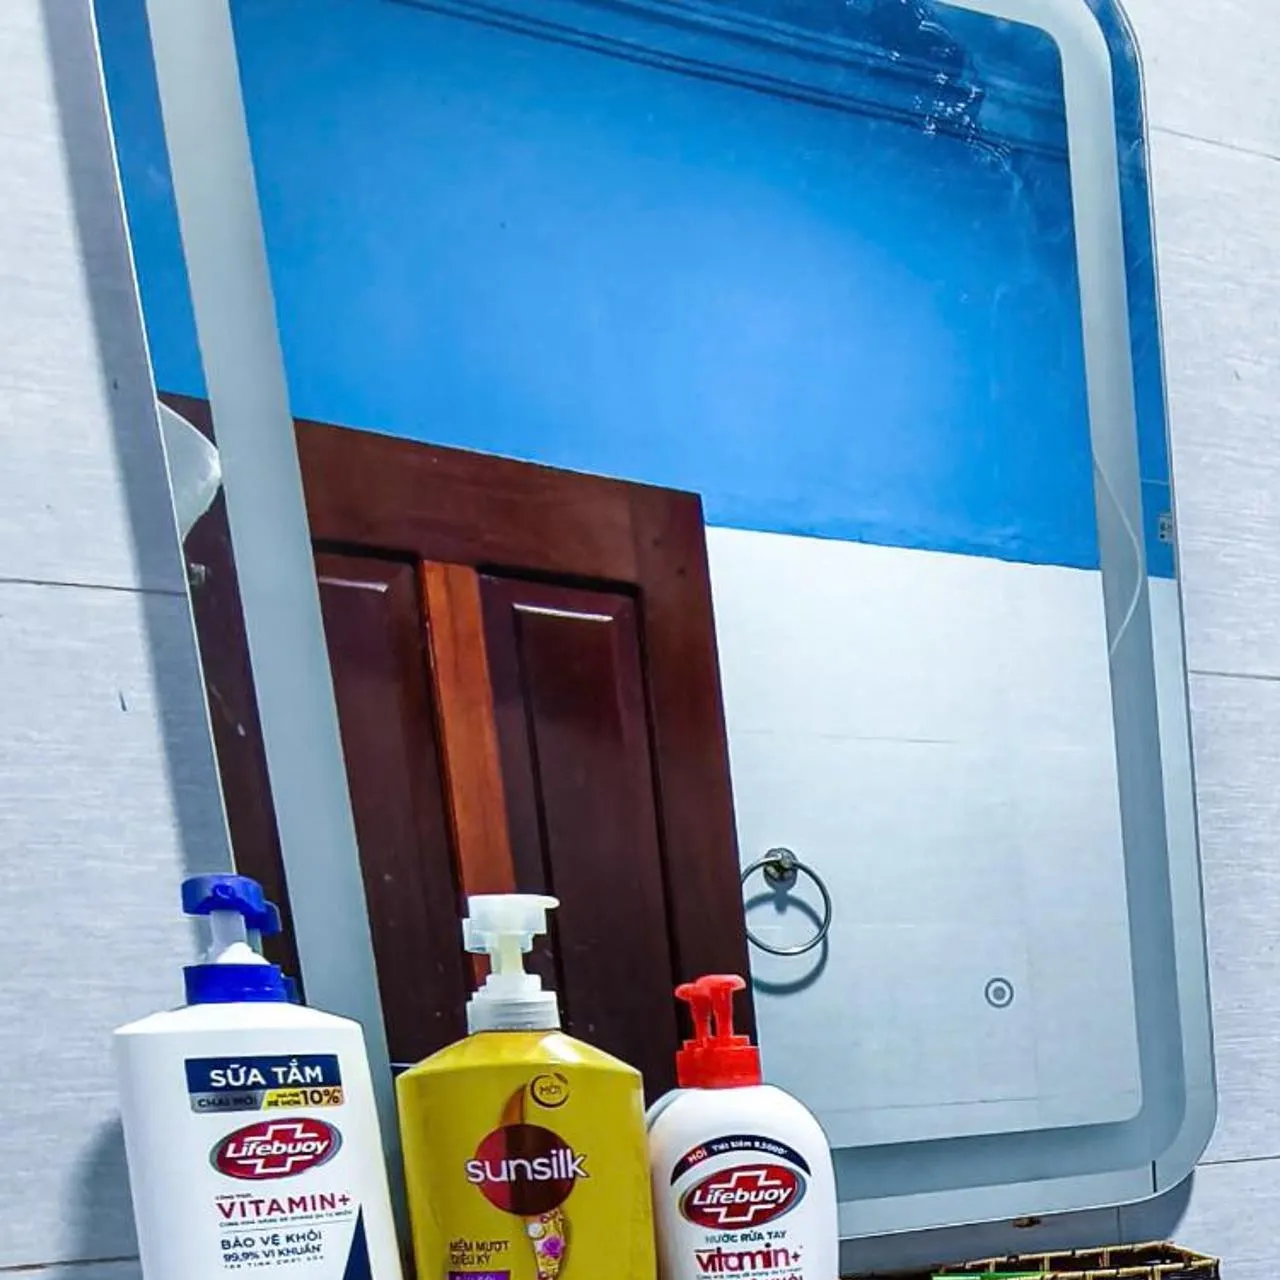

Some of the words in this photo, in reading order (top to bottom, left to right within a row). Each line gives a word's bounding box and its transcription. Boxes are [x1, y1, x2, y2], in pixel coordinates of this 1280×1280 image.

[210, 1064, 267, 1087] SỮA
[271, 1058, 323, 1084] TẮM
[301, 1089, 341, 1105] 10%
[226, 1138, 329, 1158] Lifebuoy
[466, 1149, 588, 1183] sunsilk
[216, 1193, 351, 1219] VITAMIN+
[692, 1187, 793, 1206] Lifebuoy
[221, 1235, 256, 1250] BẢO
[260, 1233, 281, 1246] VỆ
[767, 1230, 787, 1240] TAY
[223, 1251, 260, 1262] 99.9%
[262, 1249, 275, 1259] VI
